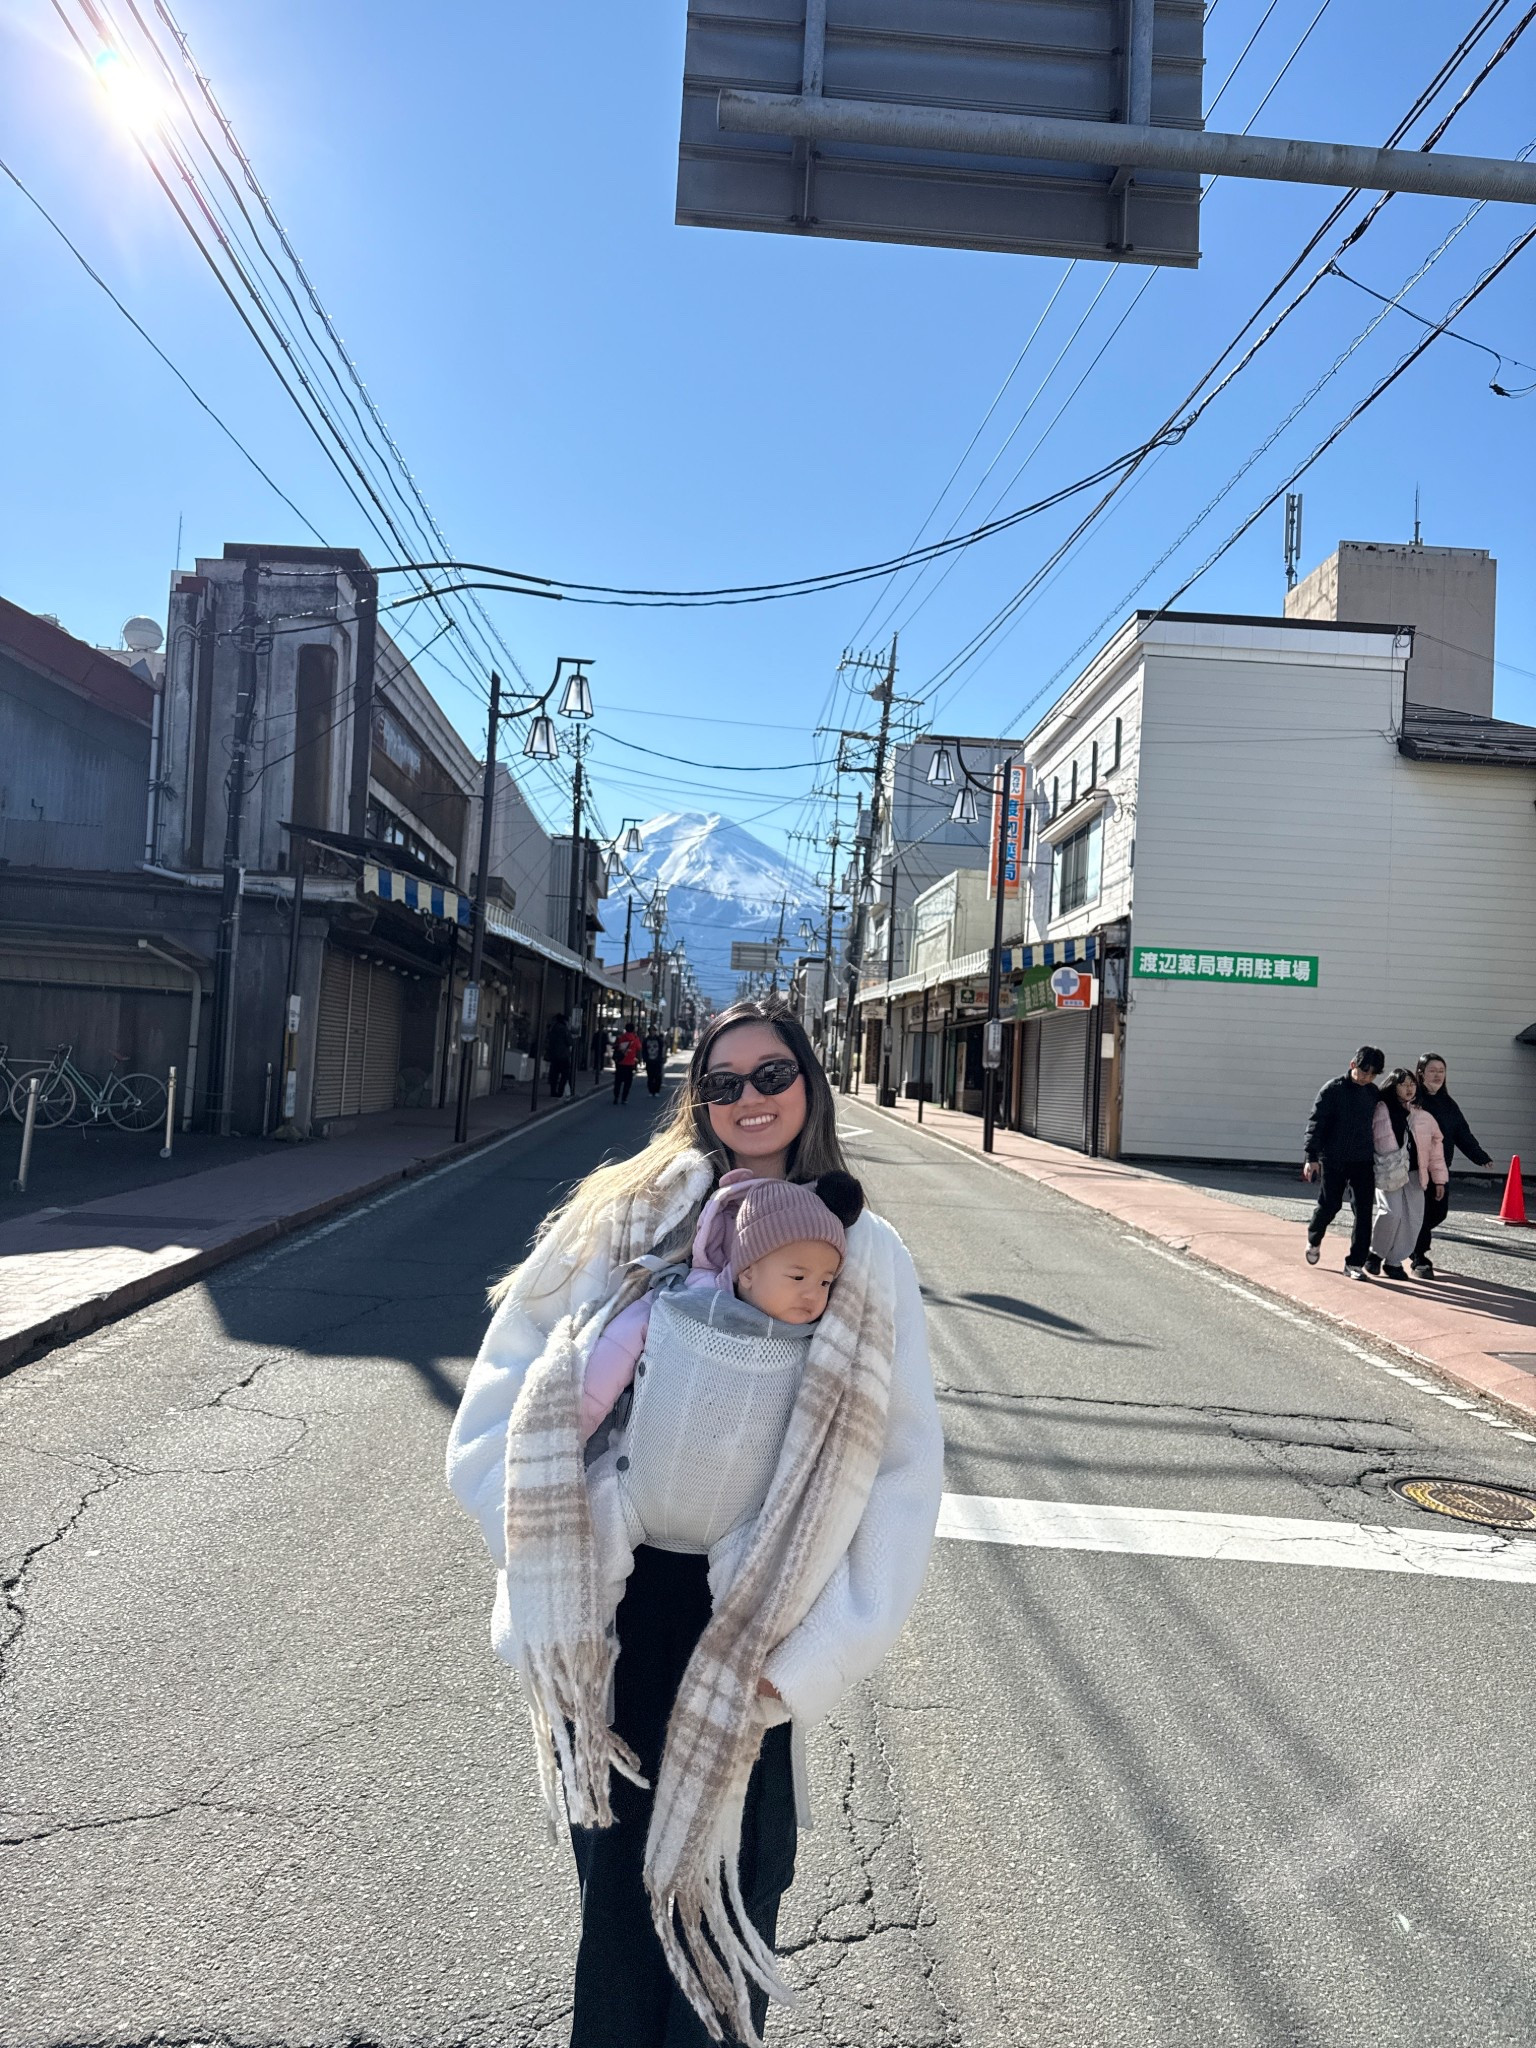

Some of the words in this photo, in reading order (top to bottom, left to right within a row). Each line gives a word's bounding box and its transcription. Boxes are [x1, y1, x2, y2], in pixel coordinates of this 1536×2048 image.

[1139, 952, 1311, 982] 渡辺薬局専用駐車場
